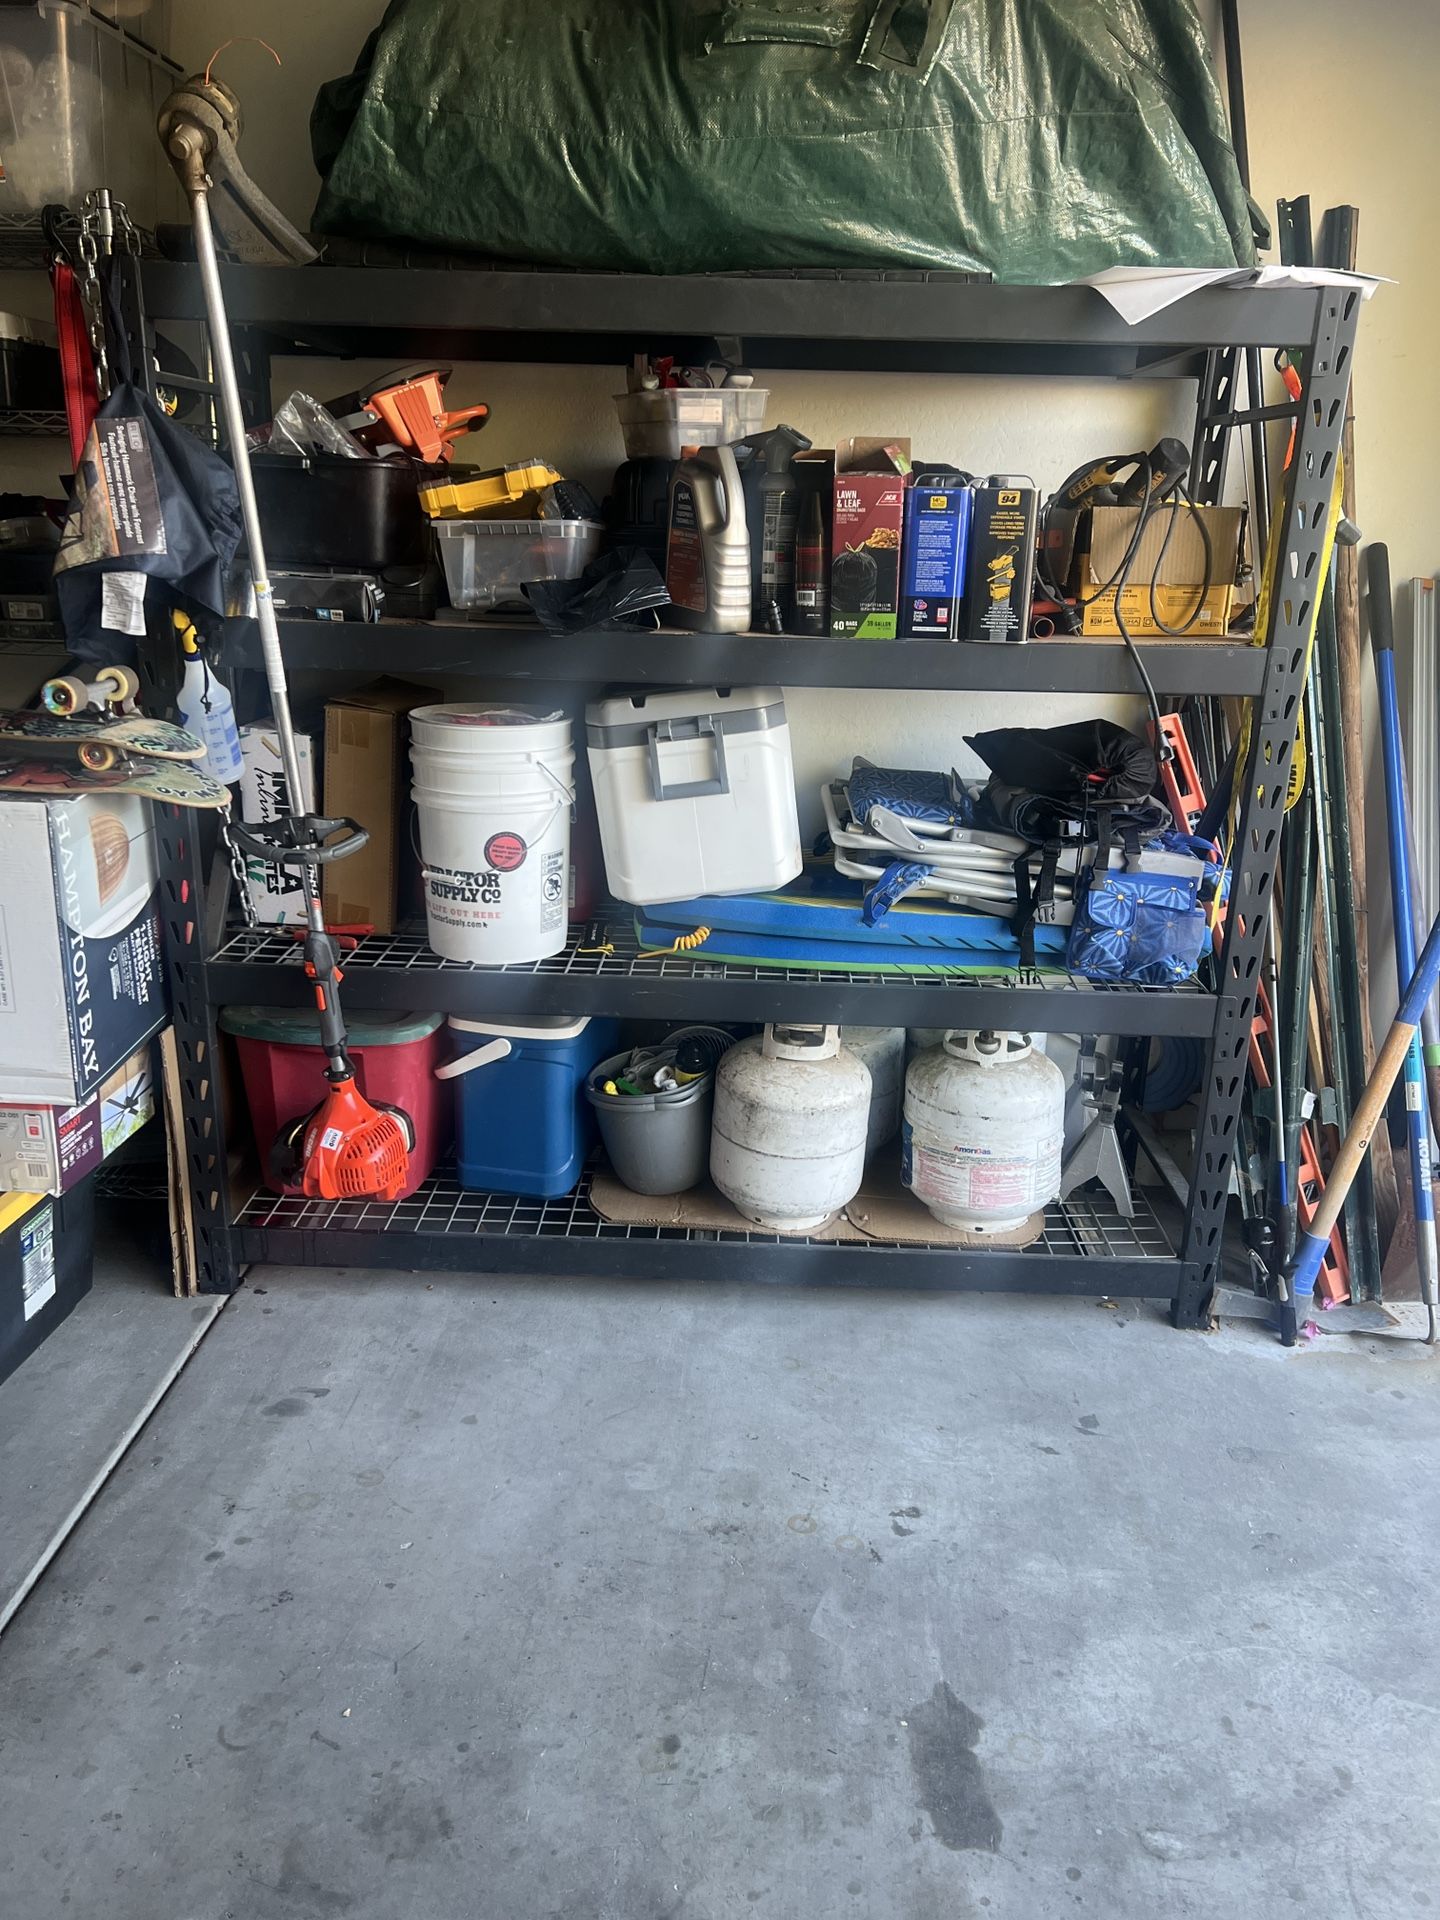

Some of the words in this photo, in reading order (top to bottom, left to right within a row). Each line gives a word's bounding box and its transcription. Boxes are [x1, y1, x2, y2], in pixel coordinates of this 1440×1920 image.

[116, 425, 128, 454] Swinging
[129, 423, 142, 448] RIO
[121, 454, 135, 486] Hammock
[127, 486, 138, 504] Chair
[836, 490, 857, 499] LAWN
[836, 499, 842, 508] &
[844, 499, 861, 508] LEAF
[1001, 495, 1017, 504] 94
[133, 518, 145, 544] Footrest
[832, 620, 845, 631] 40
[430, 880, 480, 904] SUPPLY
[432, 902, 448, 914] LIFE
[450, 908, 469, 918] OUT
[472, 910, 503, 919] HERE
[54, 810, 91, 1004] HAMPTON
[78, 1008, 100, 1081] BAY
[140, 923, 153, 982] 1-LIGHT
[133, 927, 149, 1002] PENDANT
[60, 1115, 81, 1137] SMART
[953, 1145, 992, 1155] AmeriGas
[1418, 1137, 1432, 1193] KOBALT
